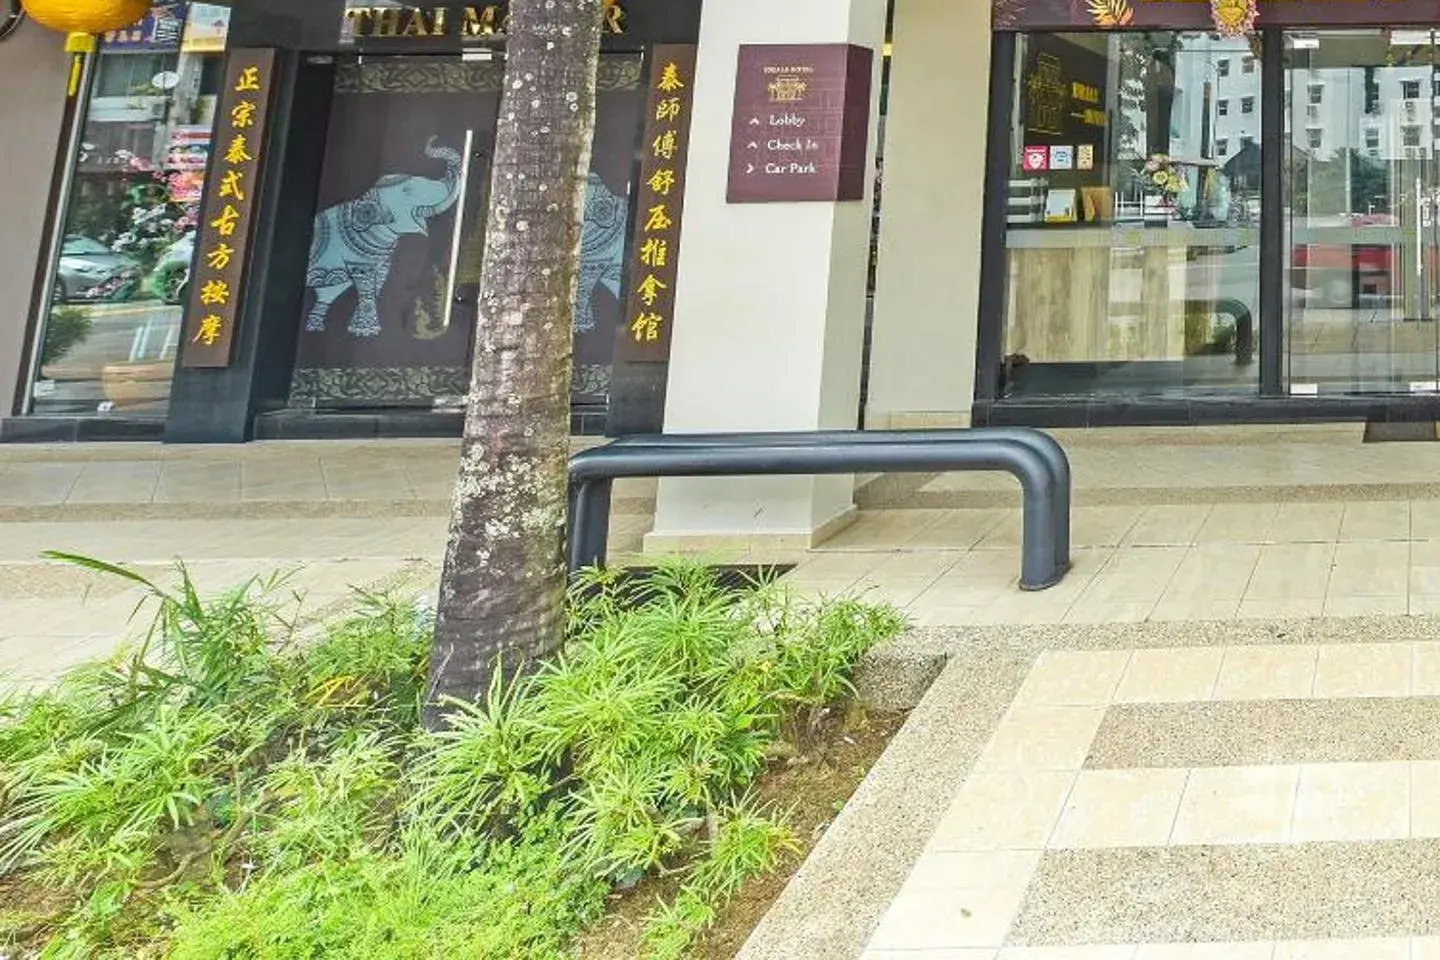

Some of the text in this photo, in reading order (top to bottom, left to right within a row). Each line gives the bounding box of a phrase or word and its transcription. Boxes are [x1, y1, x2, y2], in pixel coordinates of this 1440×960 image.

[343, 6, 447, 36] THAI
[769, 113, 806, 127] Lobby
[767, 138, 801, 151] Check
[765, 163, 816, 174] Car Park
